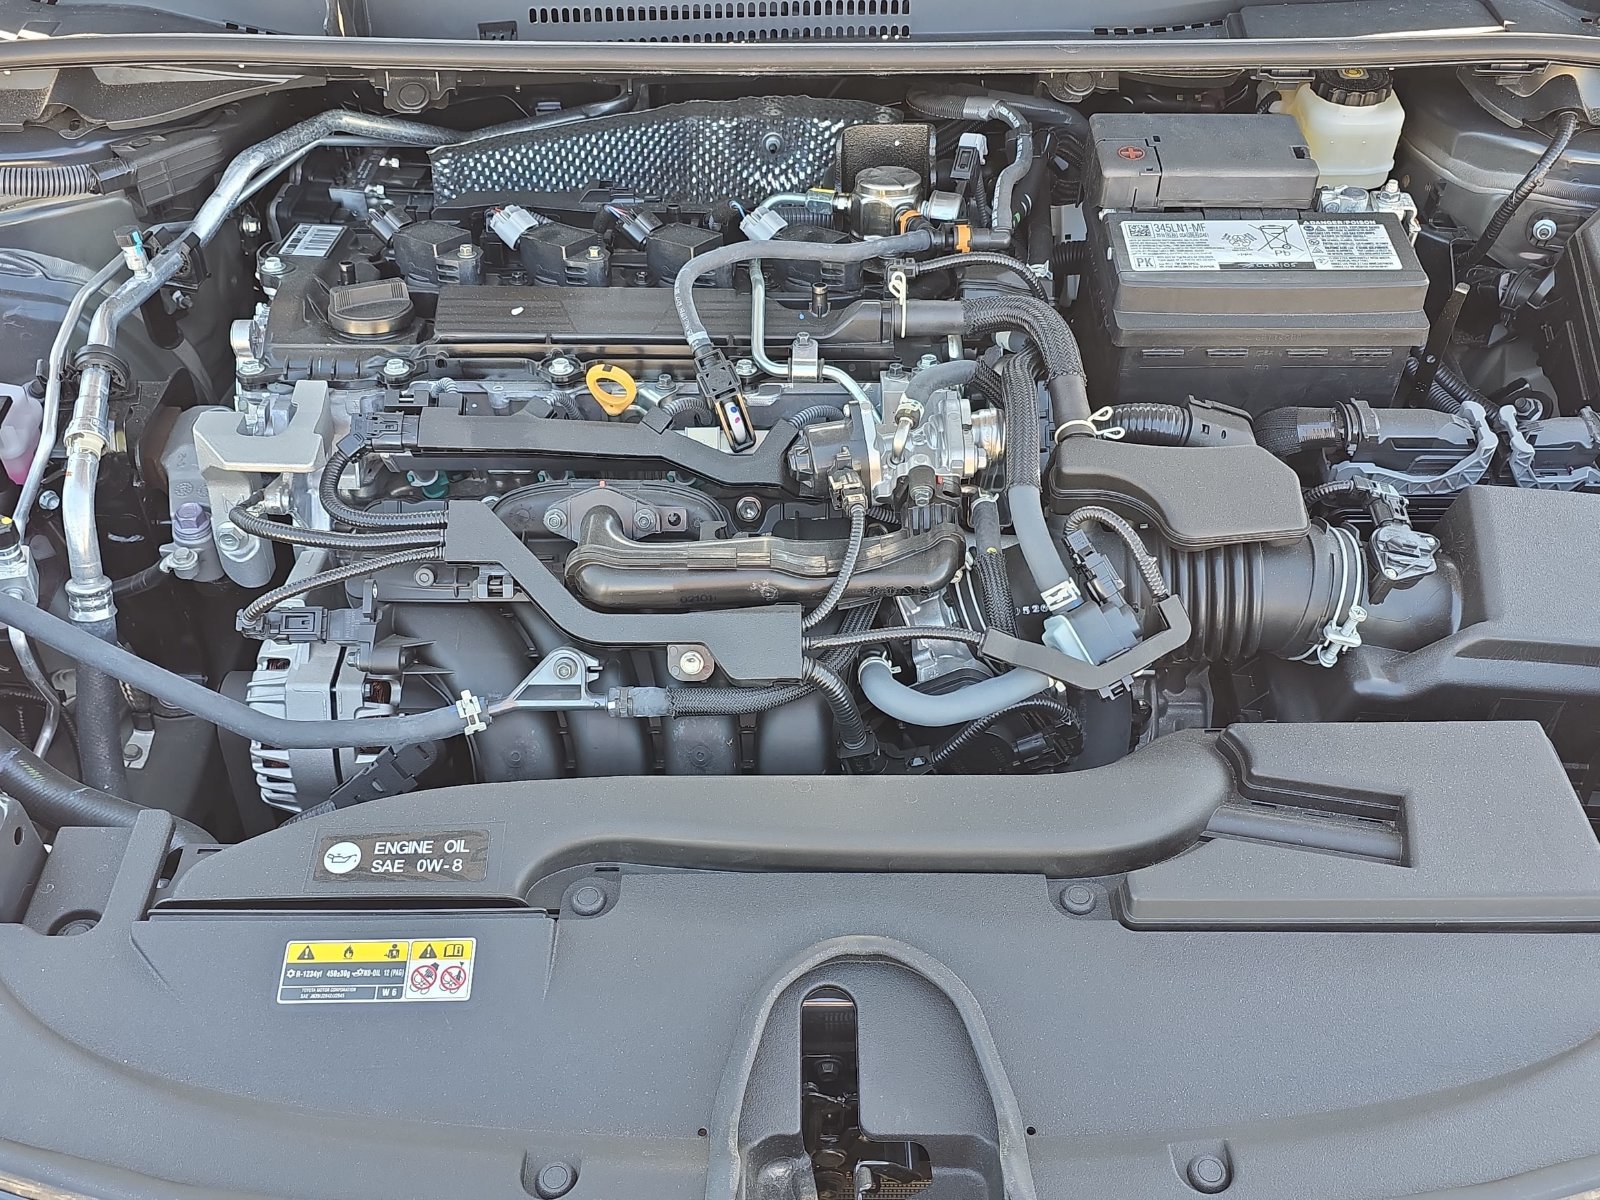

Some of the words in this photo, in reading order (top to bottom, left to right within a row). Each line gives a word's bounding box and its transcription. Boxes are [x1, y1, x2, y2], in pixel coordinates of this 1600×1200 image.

[1154, 222, 1206, 232] 345LN1-MF
[1275, 249, 1291, 257] Pb
[1136, 257, 1154, 267] PK
[374, 840, 434, 855] ENGINE
[444, 839, 470, 853] OIL
[371, 859, 405, 873] SAE
[416, 858, 463, 873] 0W-8
[295, 969, 323, 979] R-1234yf
[383, 968, 390, 977] 12
[382, 989, 390, 997] W
[391, 988, 397, 996] 6
